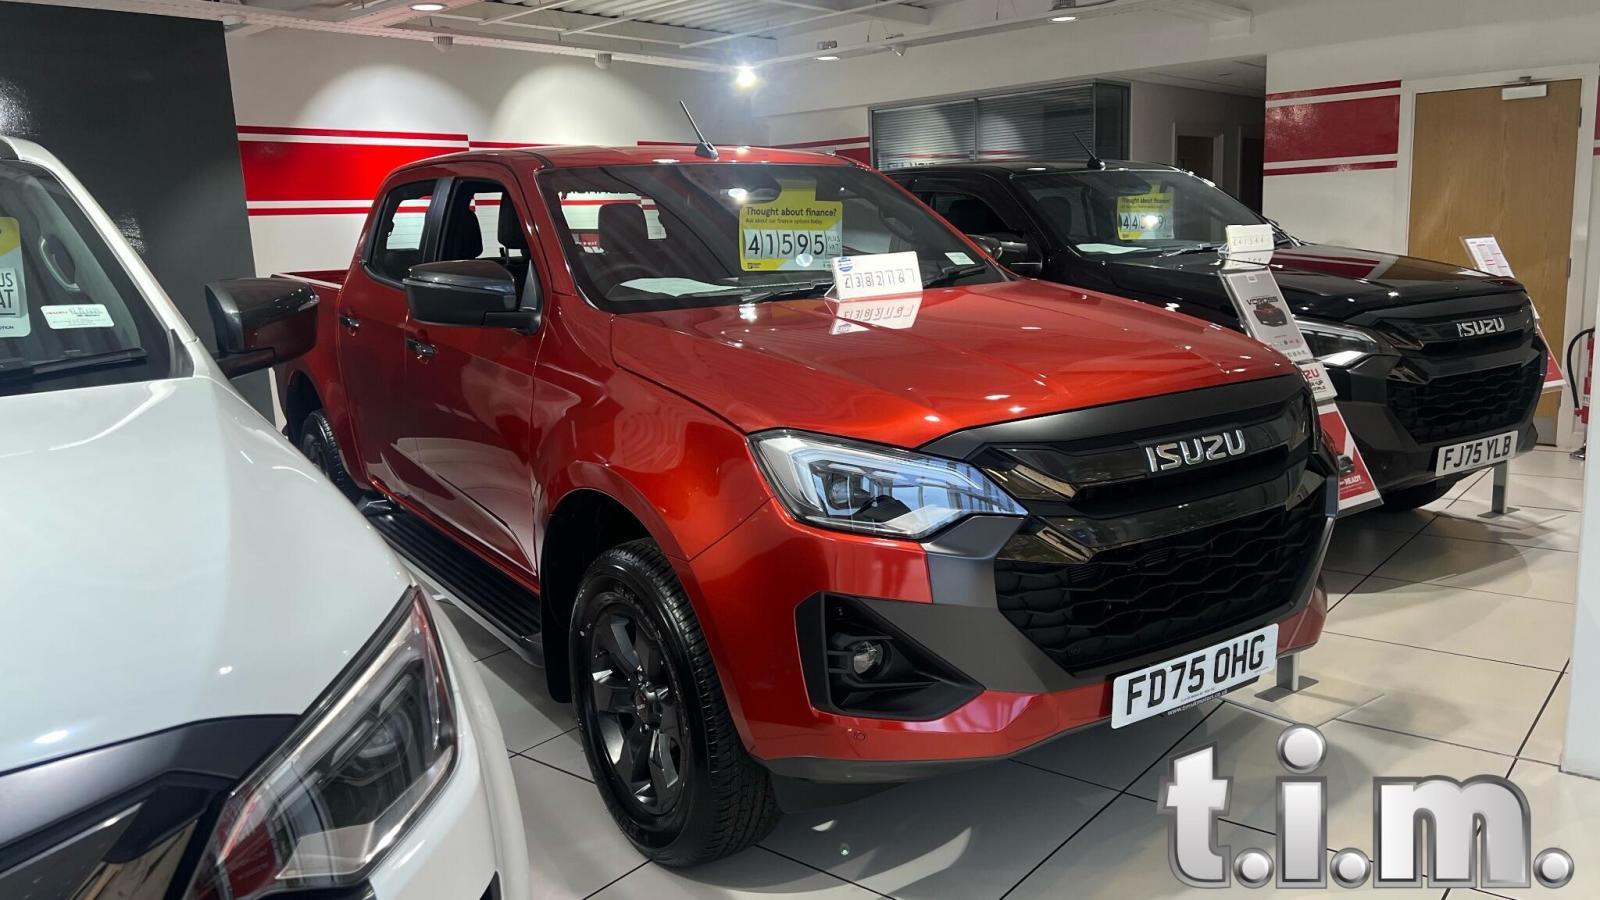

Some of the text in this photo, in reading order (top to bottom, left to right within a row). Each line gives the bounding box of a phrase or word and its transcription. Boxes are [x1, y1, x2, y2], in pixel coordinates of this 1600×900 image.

[746, 207, 837, 218] Thought about finance?
[748, 233, 825, 255] 41595
[0, 272, 14, 288] US
[0, 289, 14, 309] AT
[1457, 317, 1505, 338] ISUZU
[1145, 429, 1246, 473] ISUZU
[1442, 435, 1512, 471] FJ75 YLB
[1126, 634, 1266, 716] FD75 OHG
